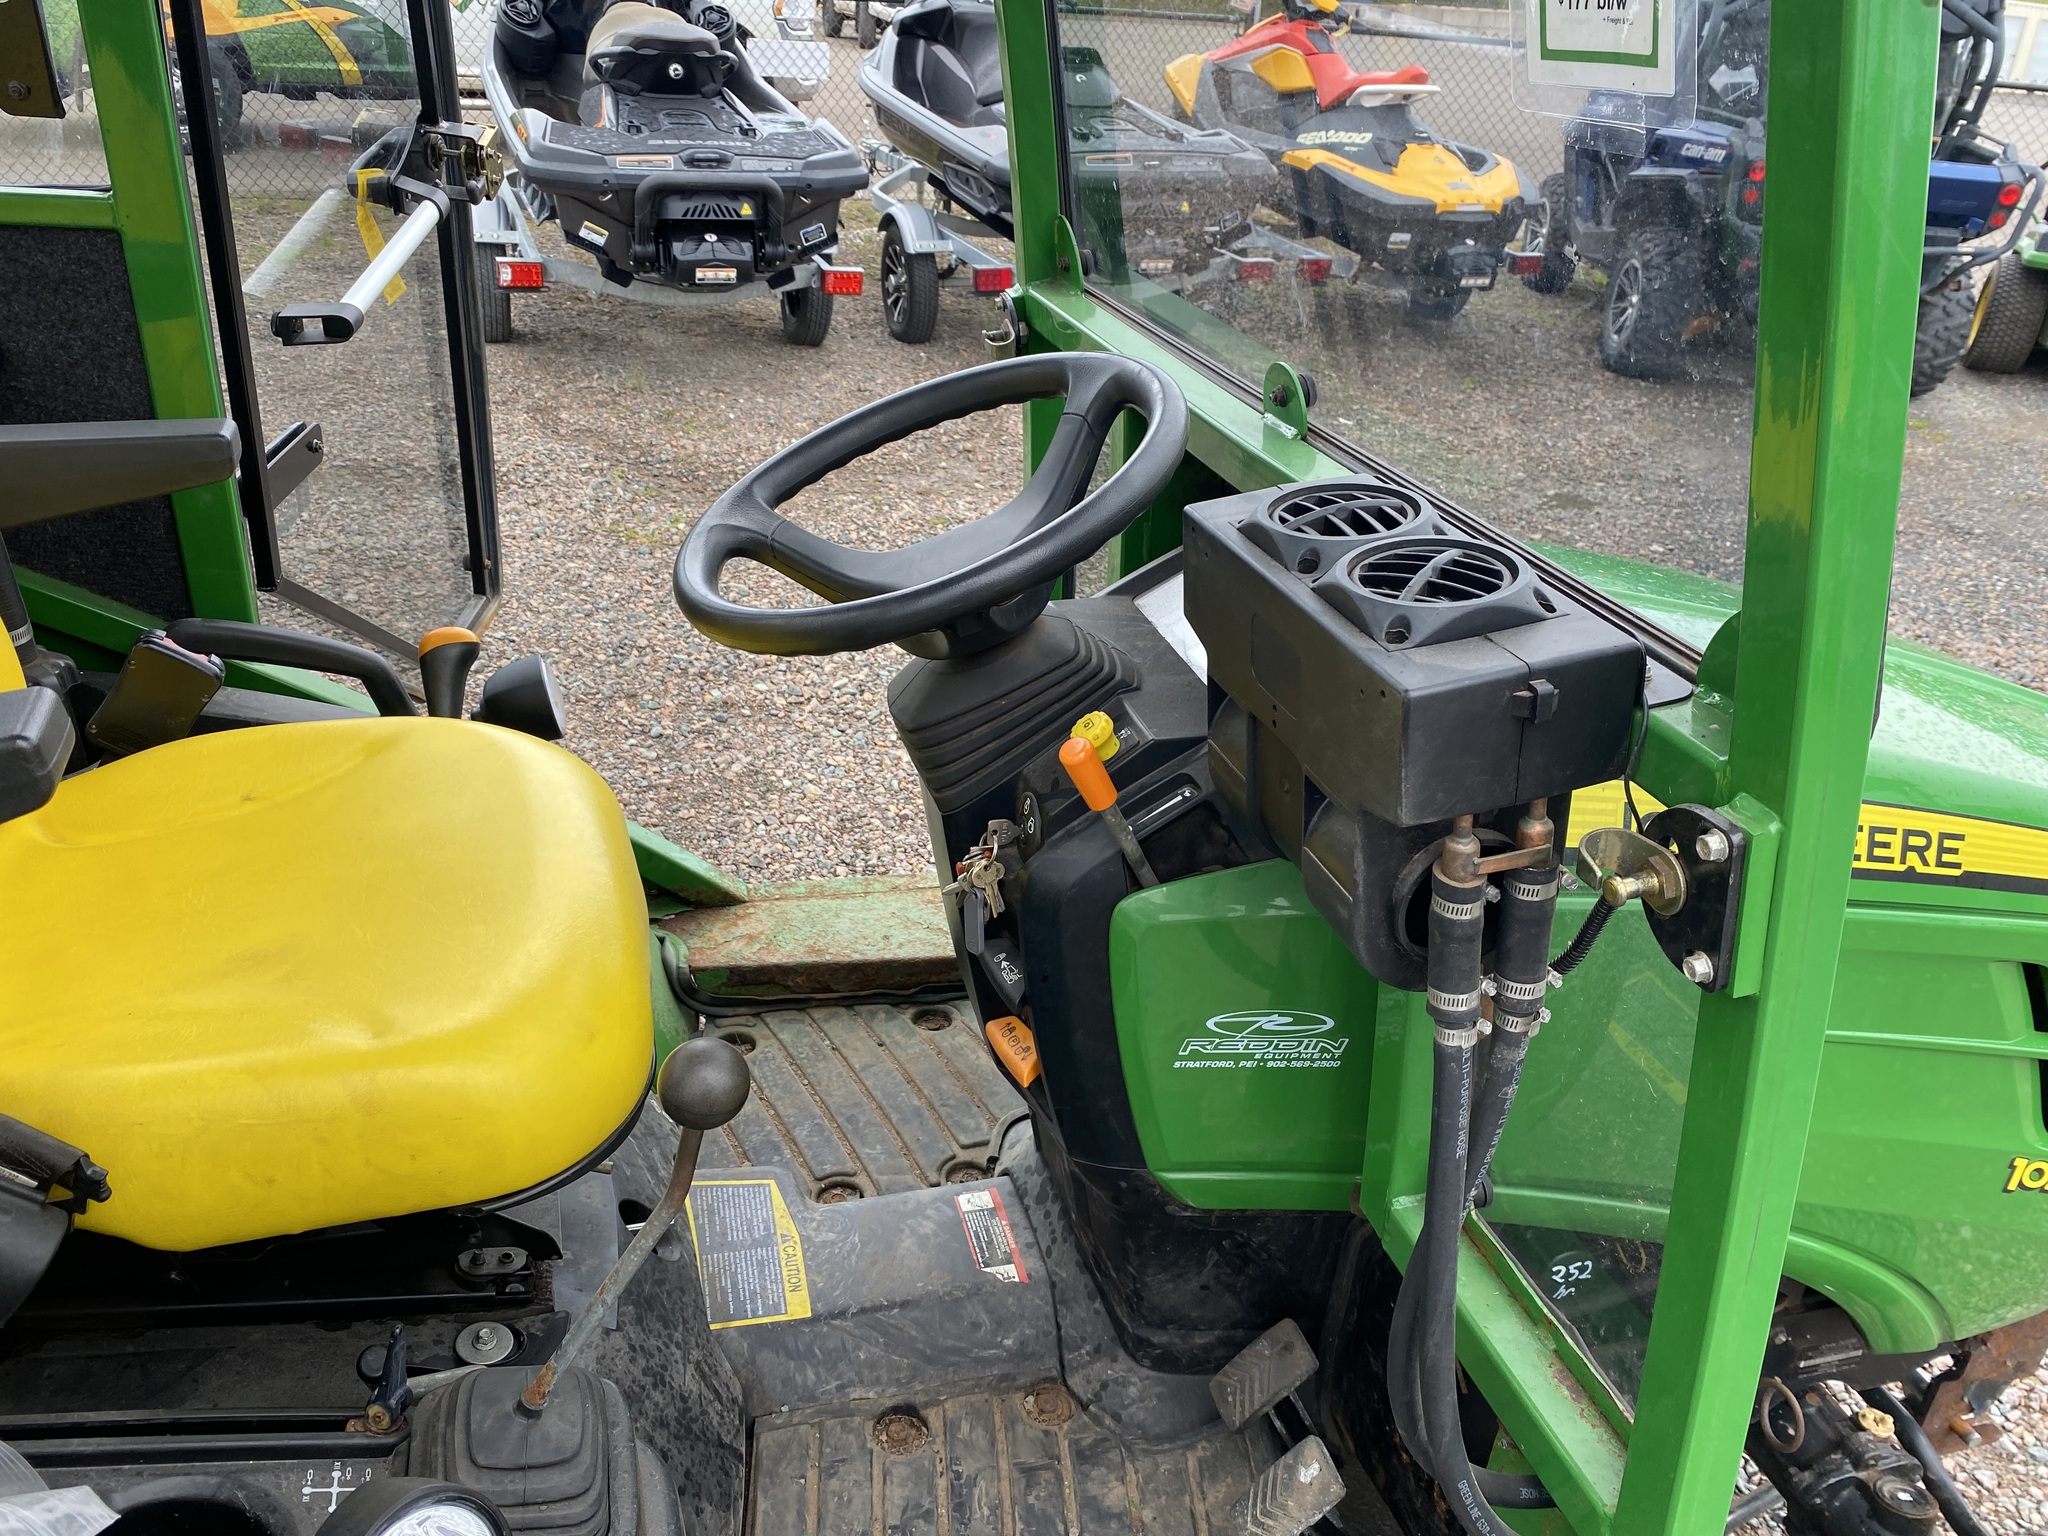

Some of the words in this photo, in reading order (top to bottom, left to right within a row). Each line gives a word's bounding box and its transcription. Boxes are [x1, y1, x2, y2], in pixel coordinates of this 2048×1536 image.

[1853, 825, 1965, 870] ERE
[1173, 1060, 1236, 1068] STRATFORD,
[1238, 1060, 1257, 1068] PEI
[1266, 1060, 1341, 1068] 902-569-2500
[1459, 1047, 1471, 1128] ULTI-PURPOSE
[1456, 1129, 1467, 1159] HOSE
[2002, 1156, 2048, 1194] 10
[1004, 1226, 1016, 1249] DANGER
[782, 1245, 802, 1293] CAUTION
[1551, 1260, 1593, 1283] 252
[1457, 1479, 1474, 1505] GREEN
